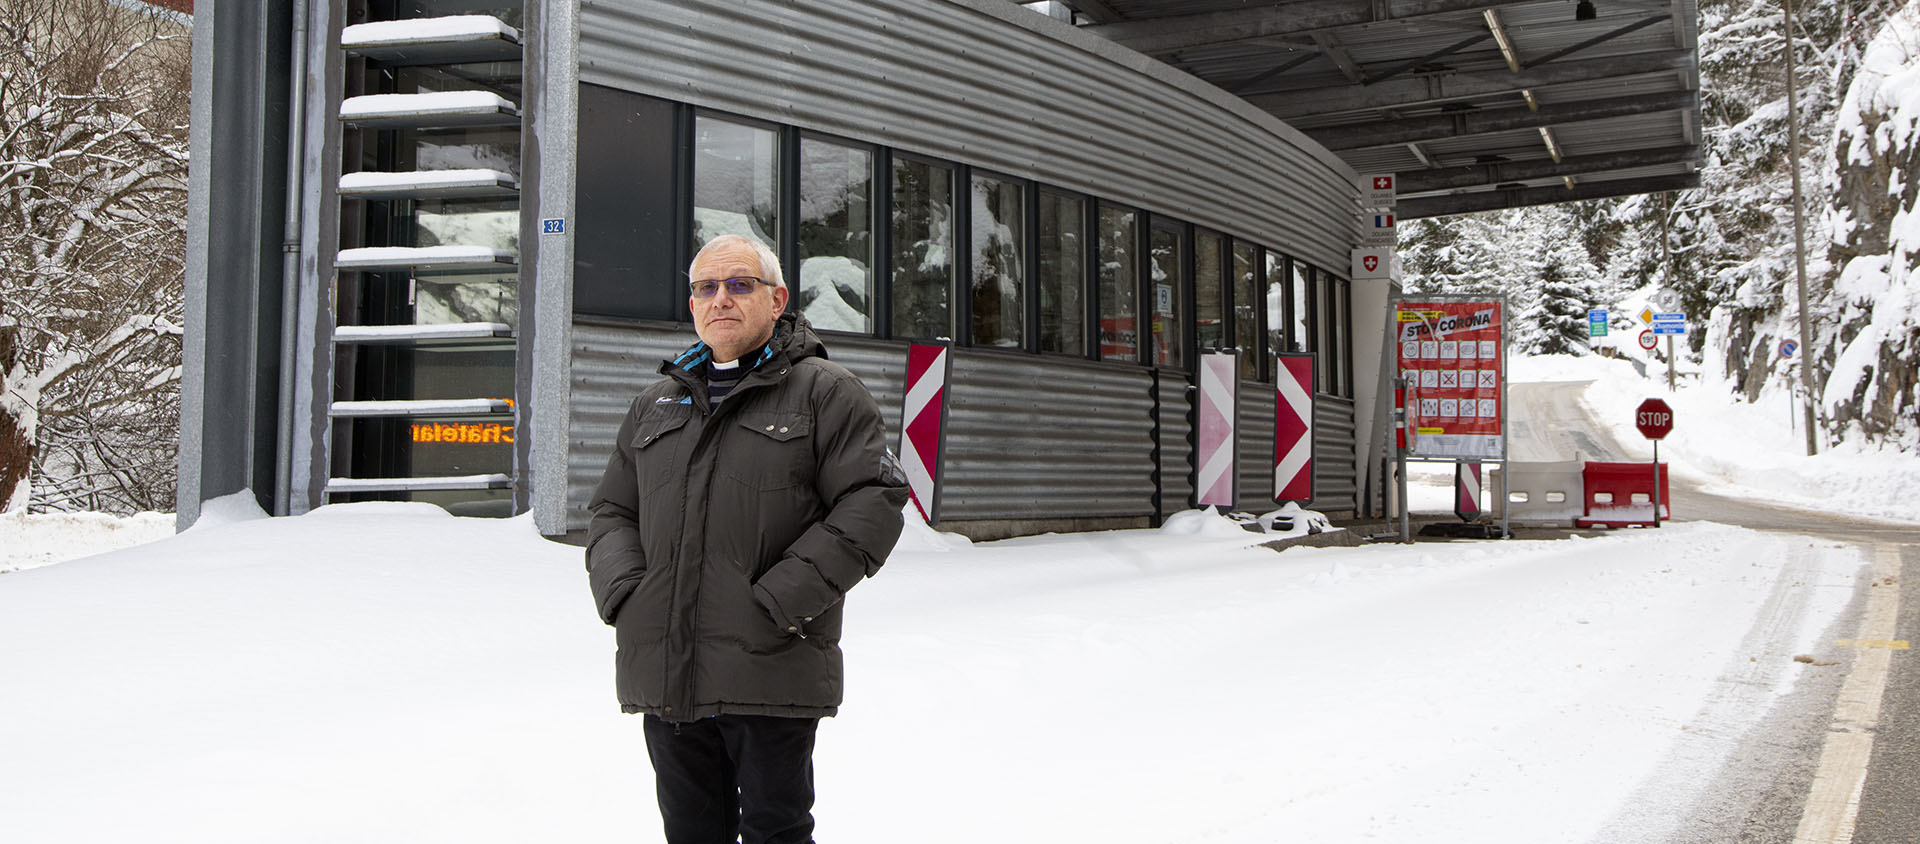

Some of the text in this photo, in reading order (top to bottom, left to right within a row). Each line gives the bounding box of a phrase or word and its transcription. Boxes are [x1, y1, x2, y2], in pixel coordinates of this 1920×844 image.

[547, 220, 560, 233] 32
[1407, 322, 1437, 337] STOP
[1440, 313, 1490, 332] CORONA
[1639, 411, 1670, 427] STOP
